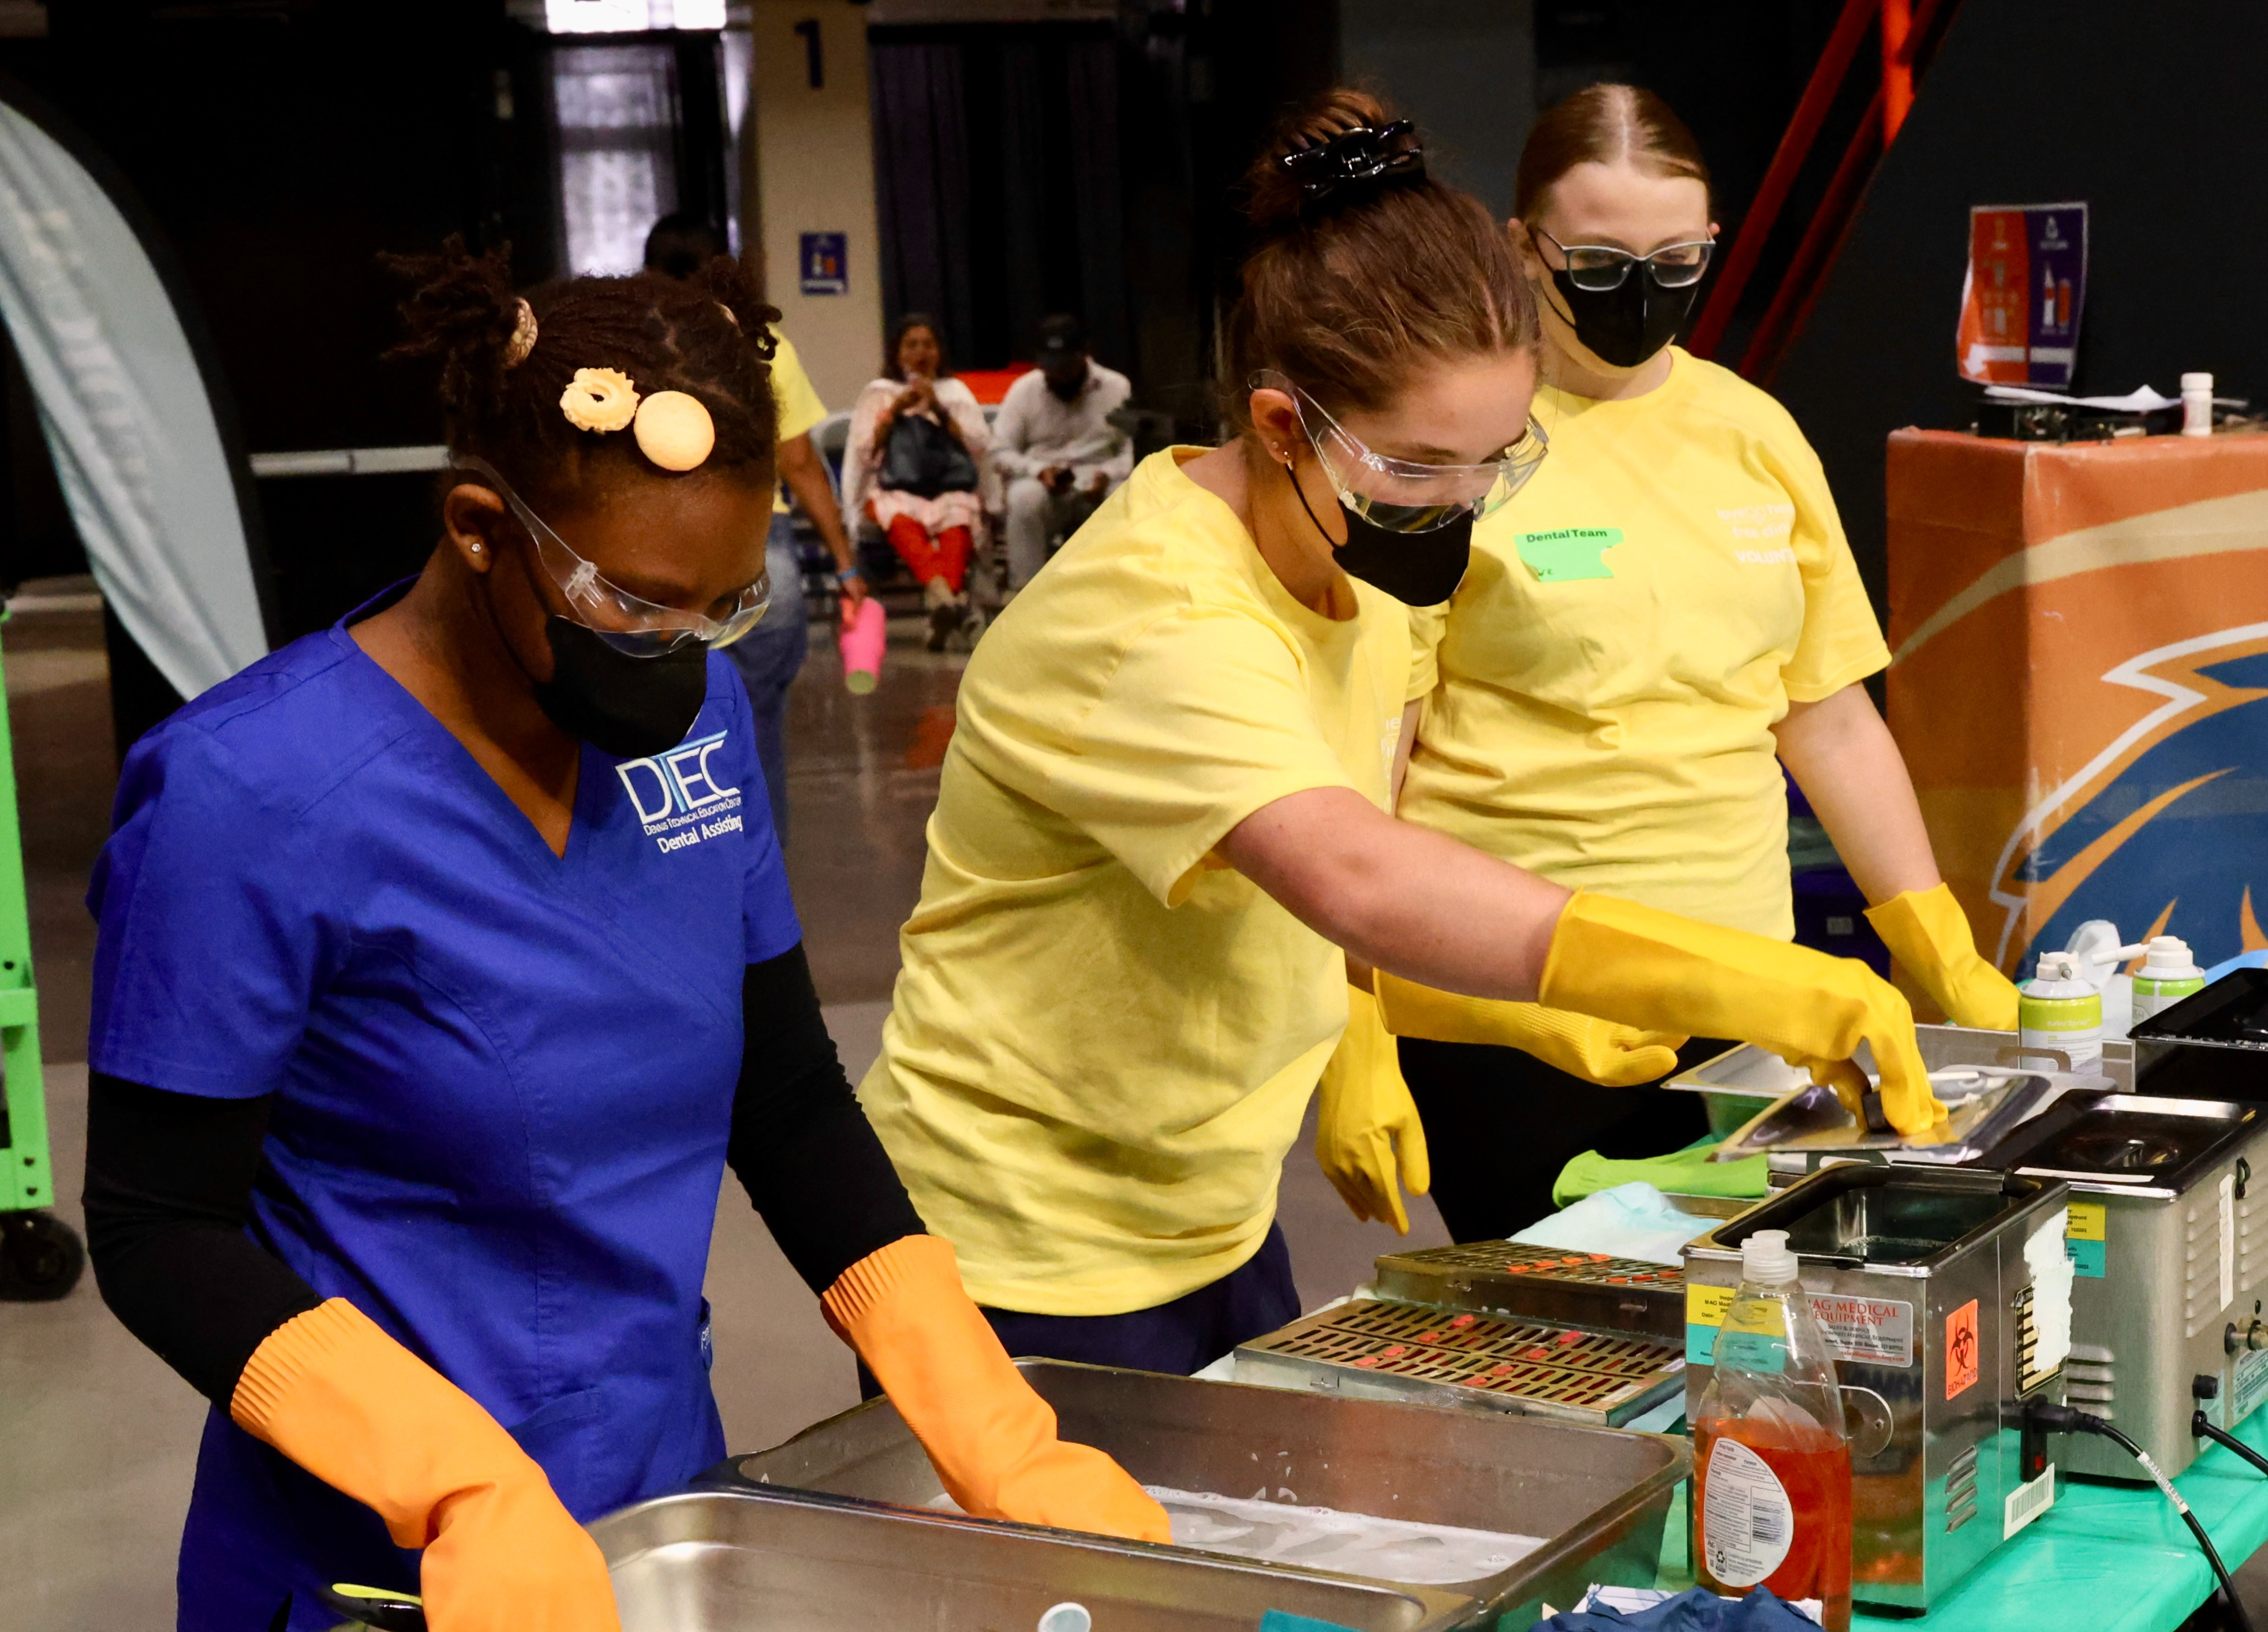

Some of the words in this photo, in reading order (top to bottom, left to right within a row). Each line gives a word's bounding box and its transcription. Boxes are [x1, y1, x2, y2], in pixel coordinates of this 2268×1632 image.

[794, 19, 824, 89] 1
[1526, 529, 1570, 543] Dental
[1571, 529, 1608, 537] Team
[656, 826, 701, 853] Dental
[701, 814, 743, 840] Assisting
[1812, 1299, 1832, 1310] AG
[1836, 1302, 1898, 1318] MEDICAL
[1814, 1310, 1884, 1325] EQUIPMENT
[1948, 1367, 1977, 1395] BIOHAZARD
